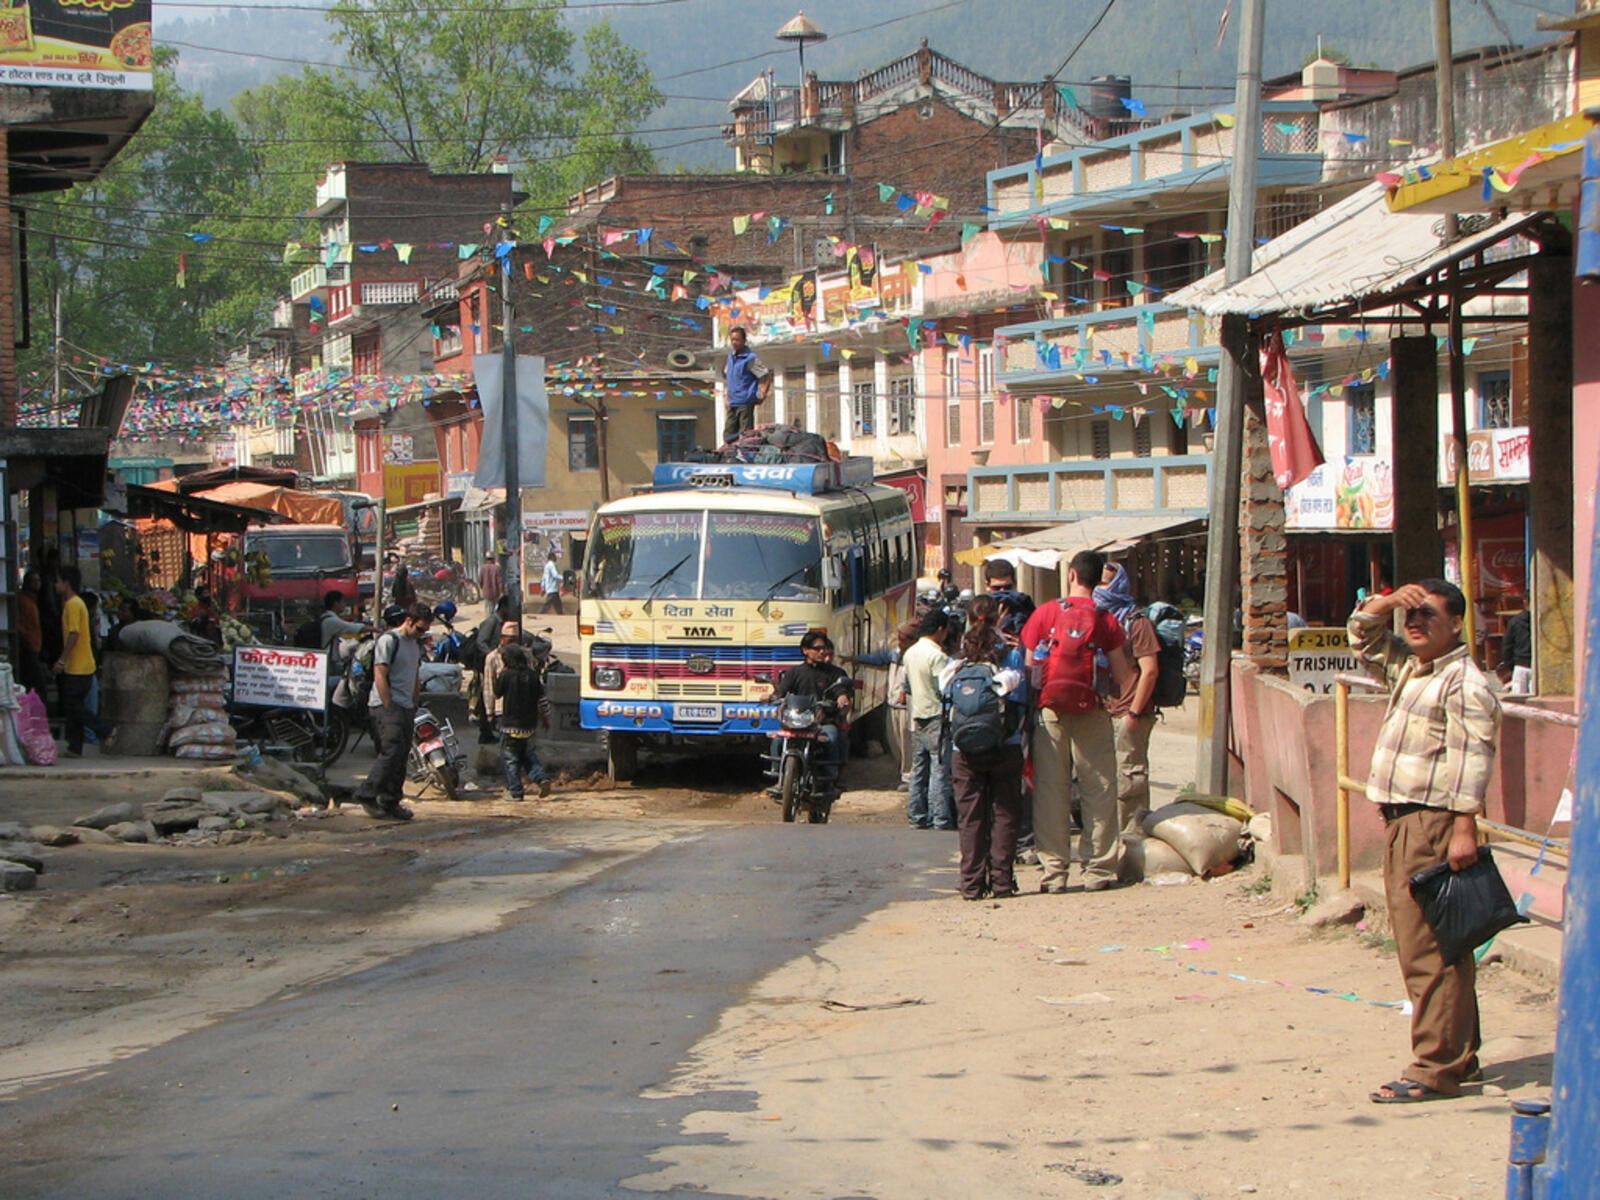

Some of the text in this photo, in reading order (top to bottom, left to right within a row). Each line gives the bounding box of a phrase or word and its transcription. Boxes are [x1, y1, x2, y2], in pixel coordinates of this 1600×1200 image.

[663, 604, 735, 617] दिवा सेवा
[683, 627, 717, 637] TATA
[1293, 656, 1358, 671] TRISHULI
[597, 702, 663, 718] SPEED
